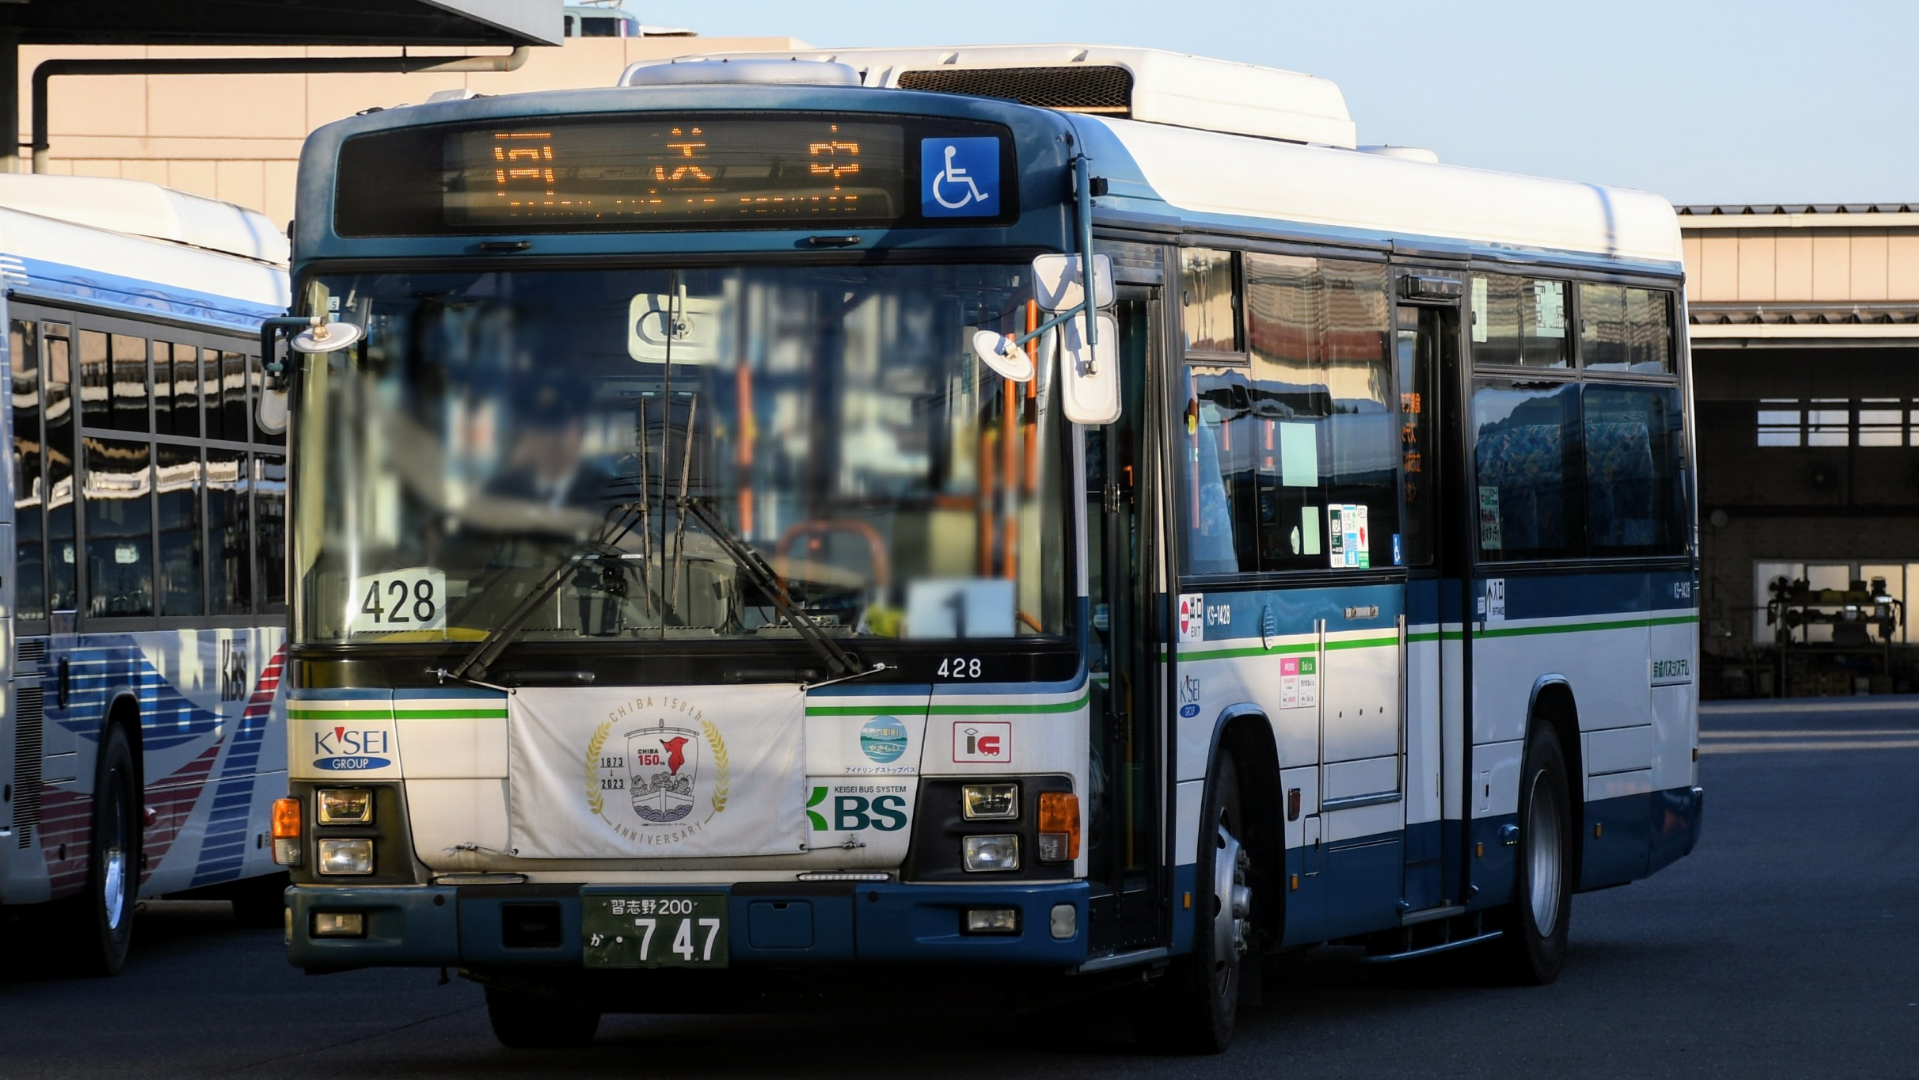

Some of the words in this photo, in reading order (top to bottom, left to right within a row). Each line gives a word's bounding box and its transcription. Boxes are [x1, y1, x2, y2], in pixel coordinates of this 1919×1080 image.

[360, 578, 436, 624] 428
[1189, 596, 1202, 620] 出口
[1206, 604, 1231, 626] KS-1428
[221, 638, 247, 702] KBS
[937, 657, 982, 678] 428
[1653, 659, 1690, 679] 京成バスシステム
[609, 697, 653, 723] CHIBA
[663, 697, 702, 722] 150th
[332, 757, 369, 770] GROUP
[600, 756, 623, 767] 1873
[845, 766, 916, 774] アイドリングストップバス
[601, 778, 624, 789] 2023
[834, 785, 858, 794] KEISEI
[859, 785, 875, 794] BUS
[876, 785, 907, 794] SYSTEM
[612, 822, 702, 846] ANNIVERSARY
[590, 933, 604, 947] か
